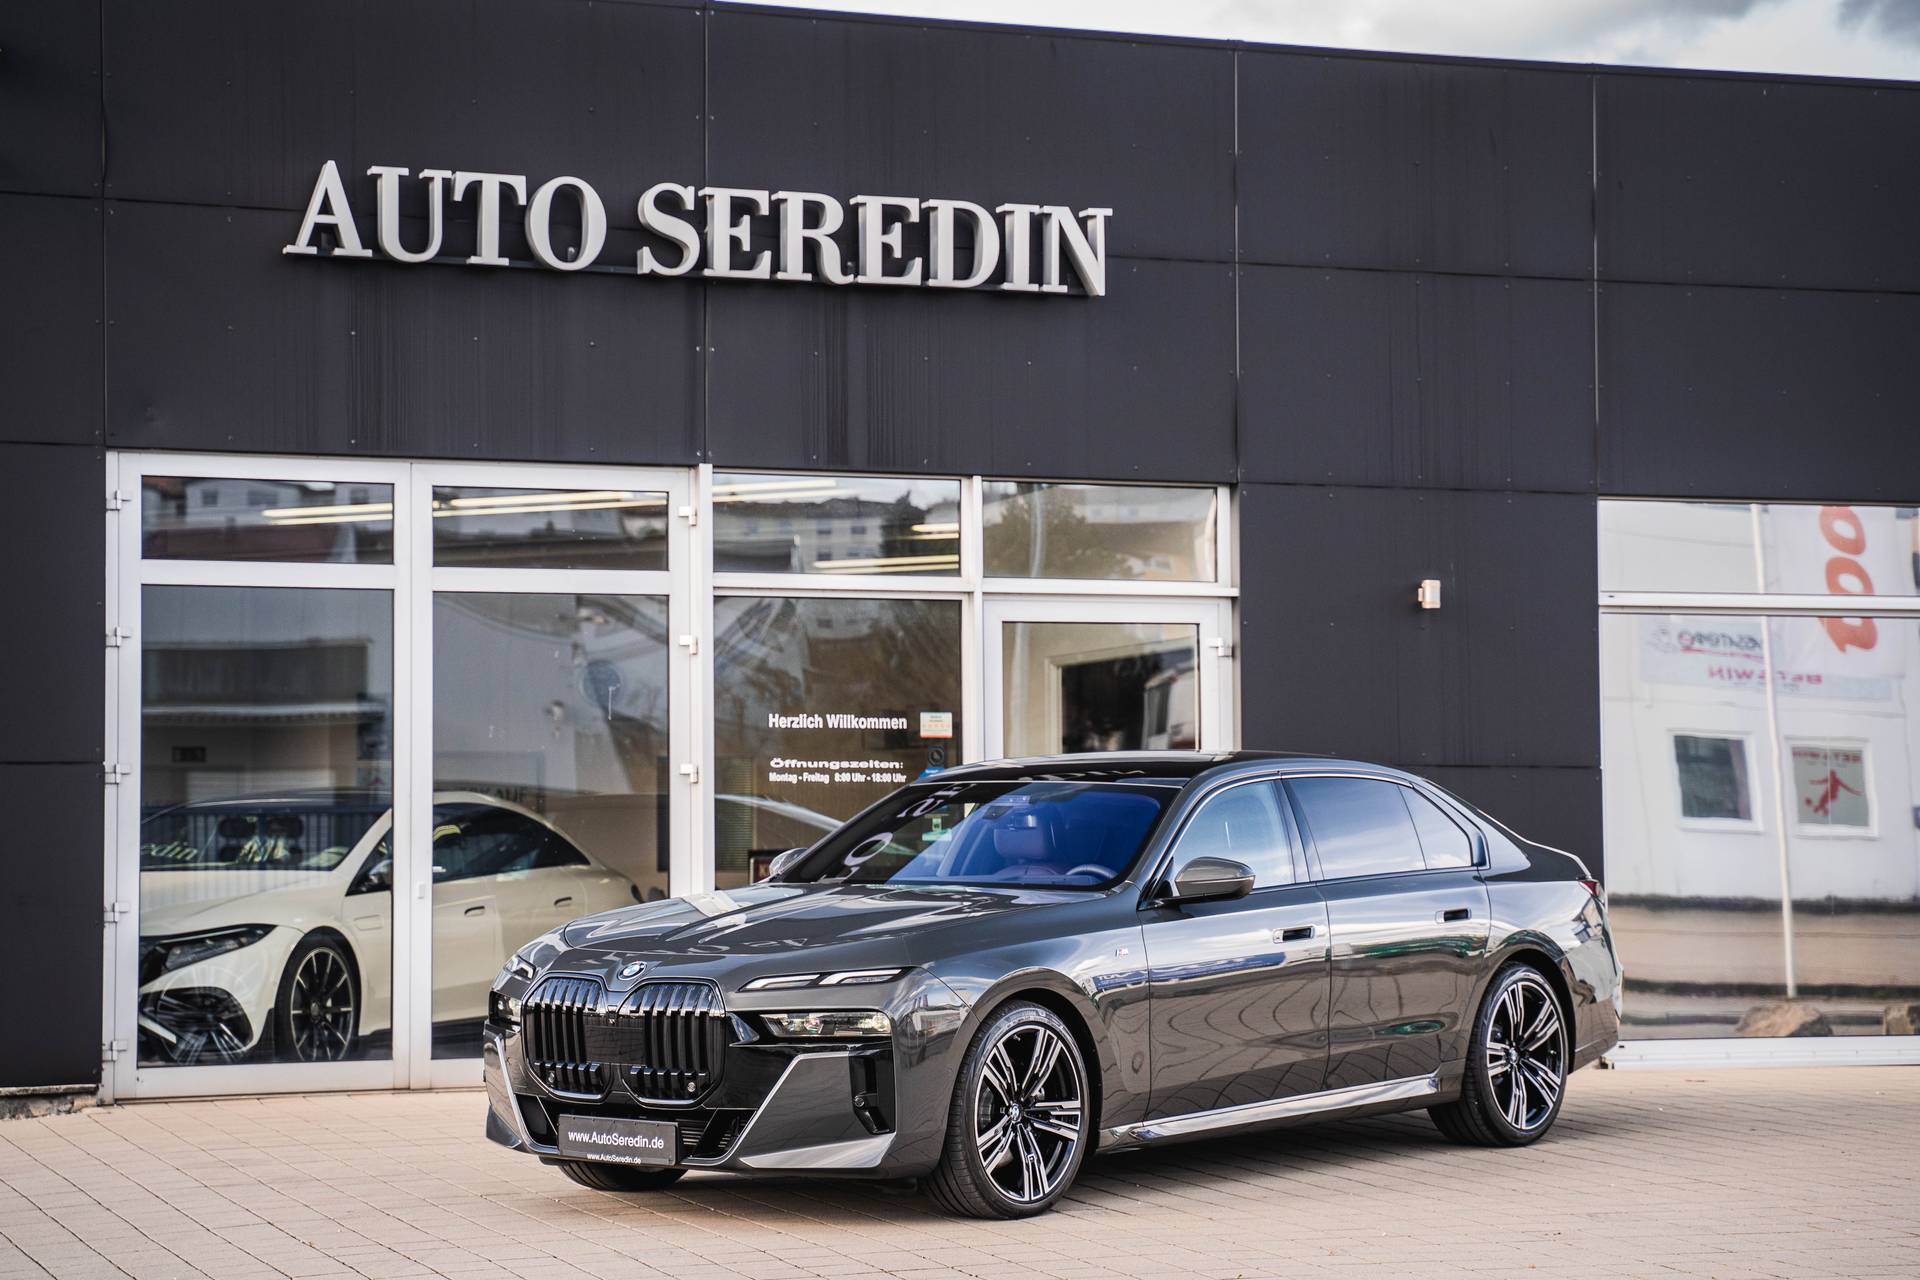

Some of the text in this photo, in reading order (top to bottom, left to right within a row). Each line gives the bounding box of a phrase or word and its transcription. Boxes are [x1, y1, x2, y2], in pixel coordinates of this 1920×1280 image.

[282, 159, 1114, 297] AUTO SEREDIN
[768, 713, 823, 729] Herzlich
[826, 714, 907, 730] Willkommen
[770, 757, 904, 769] Öffnungszeiten:
[768, 772, 798, 784] Montag
[803, 773, 829, 784] Freitag
[834, 773, 851, 782] 8:00
[853, 773, 866, 782] Uhr
[892, 773, 907, 783] Uhr
[568, 1131, 664, 1149] www.AutoSeredin.de
[586, 1152, 641, 1165] www.AutoSeredin.de
